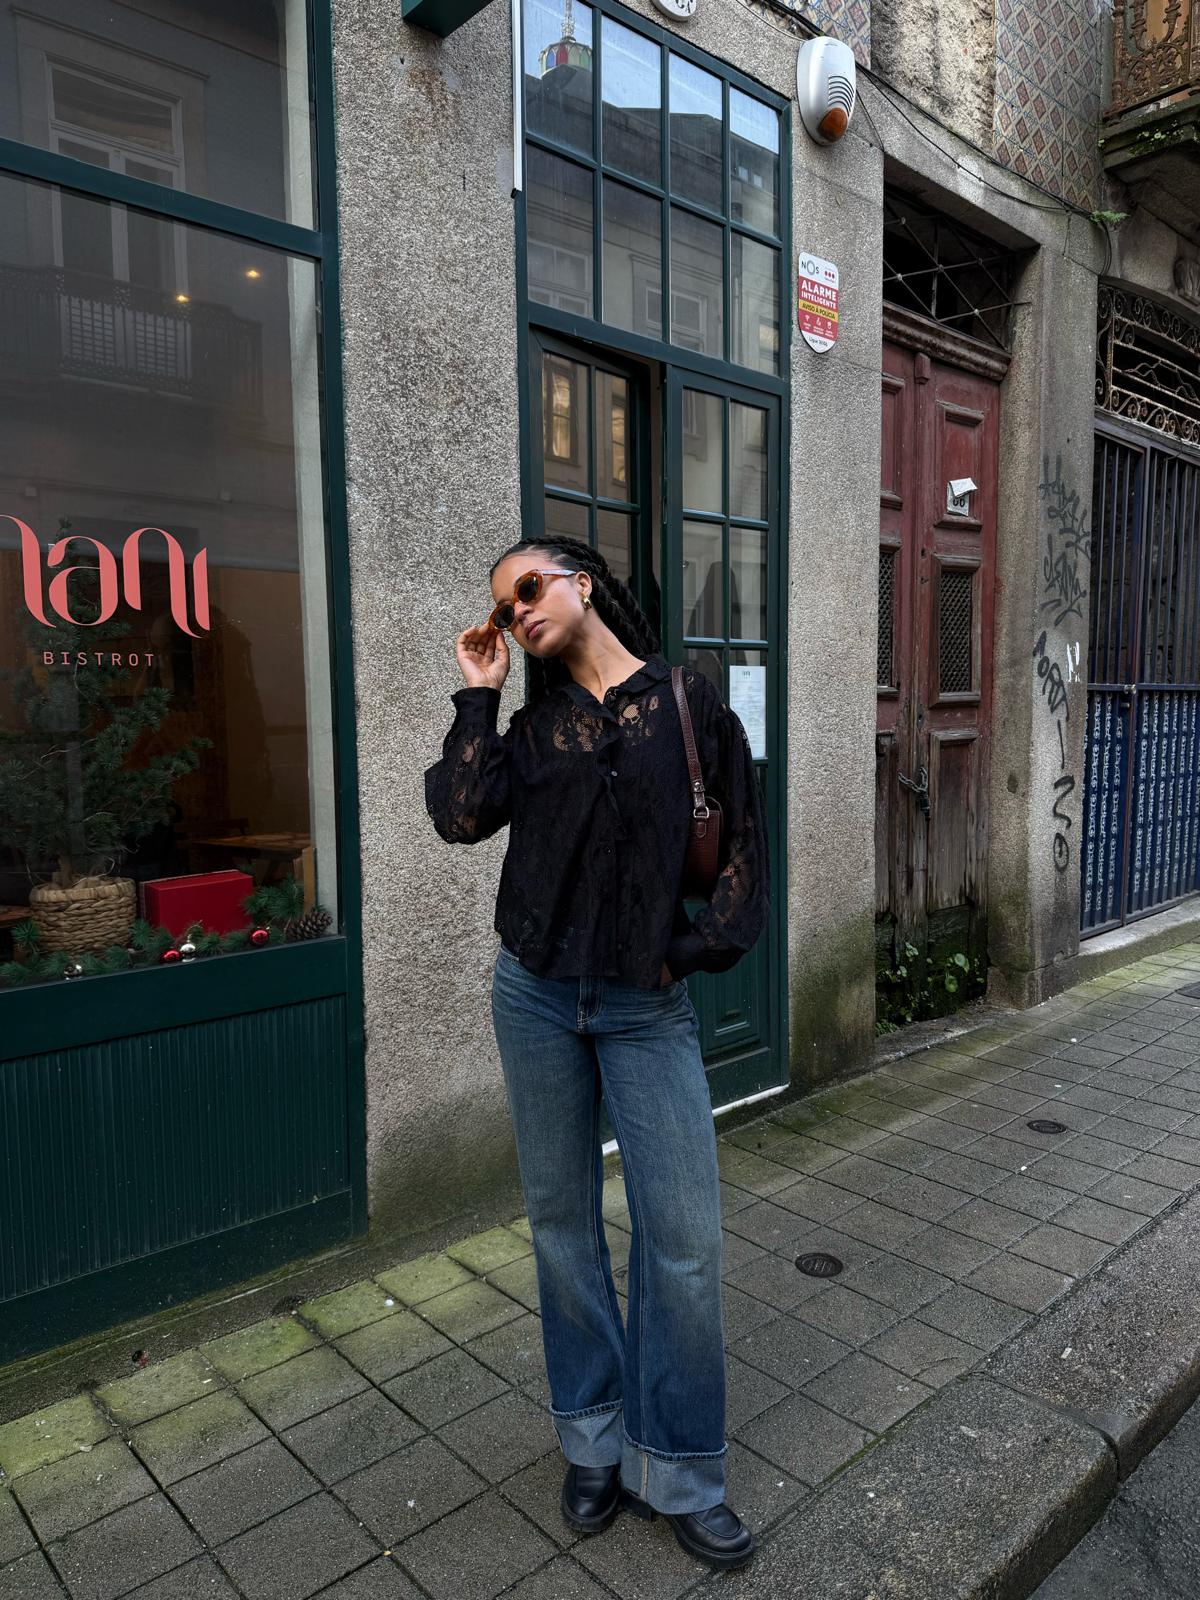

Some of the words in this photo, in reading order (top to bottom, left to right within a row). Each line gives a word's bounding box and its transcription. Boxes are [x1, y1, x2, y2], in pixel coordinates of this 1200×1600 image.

[801, 260, 820, 276] NOS
[801, 279, 837, 302] ALARME
[801, 290, 837, 309] INTELIGENTE
[43, 651, 155, 667] BISTROT
